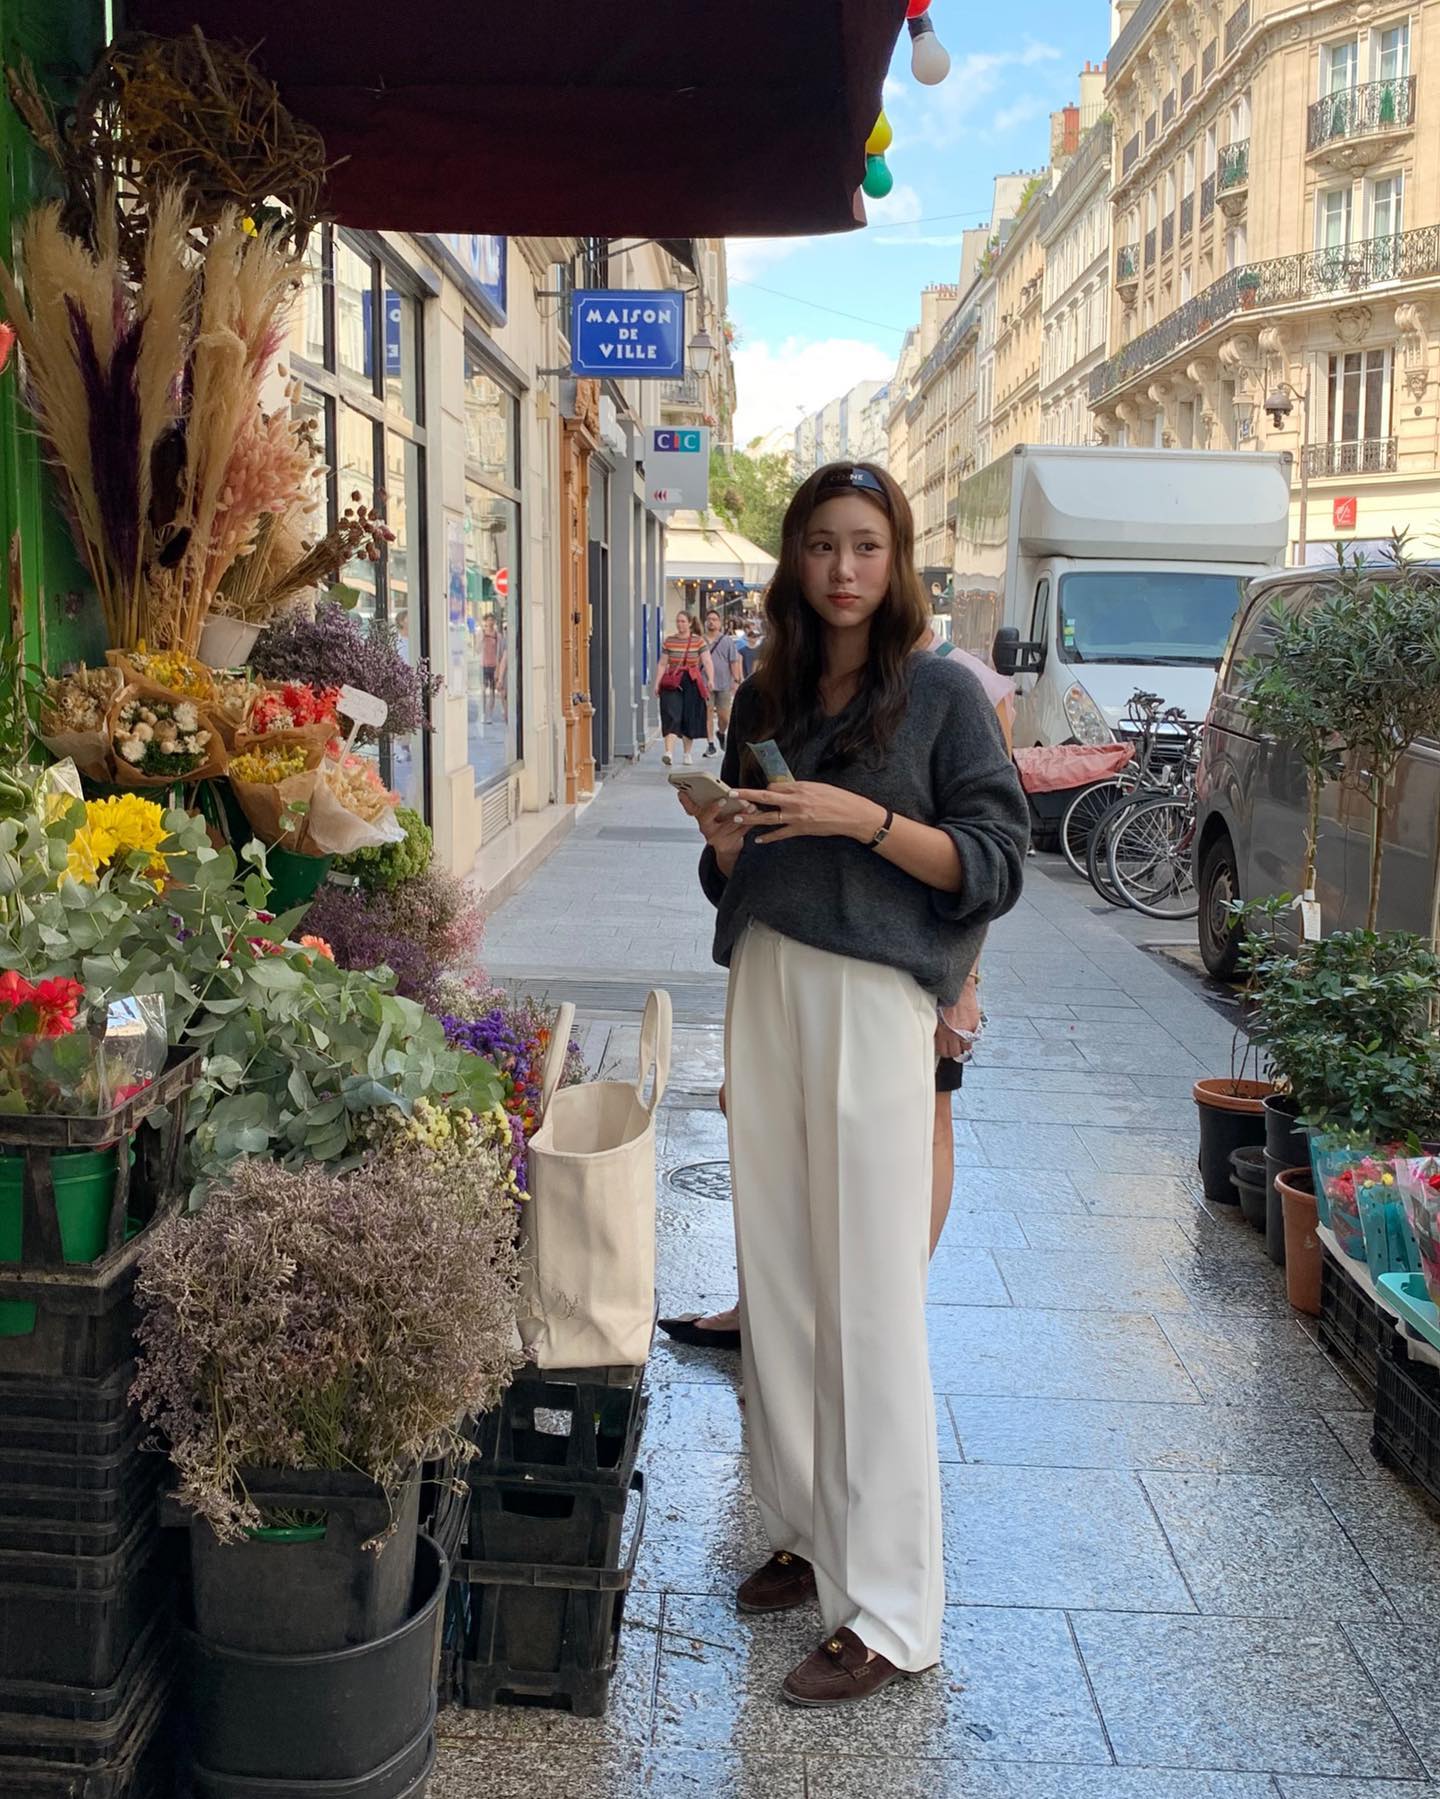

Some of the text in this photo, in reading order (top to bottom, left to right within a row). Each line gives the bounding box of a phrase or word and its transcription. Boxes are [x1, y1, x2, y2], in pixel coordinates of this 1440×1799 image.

[585, 309, 671, 324] MAISON
[619, 328, 638, 340] DE
[598, 344, 657, 359] VILLE
[657, 433, 697, 449] CIC
